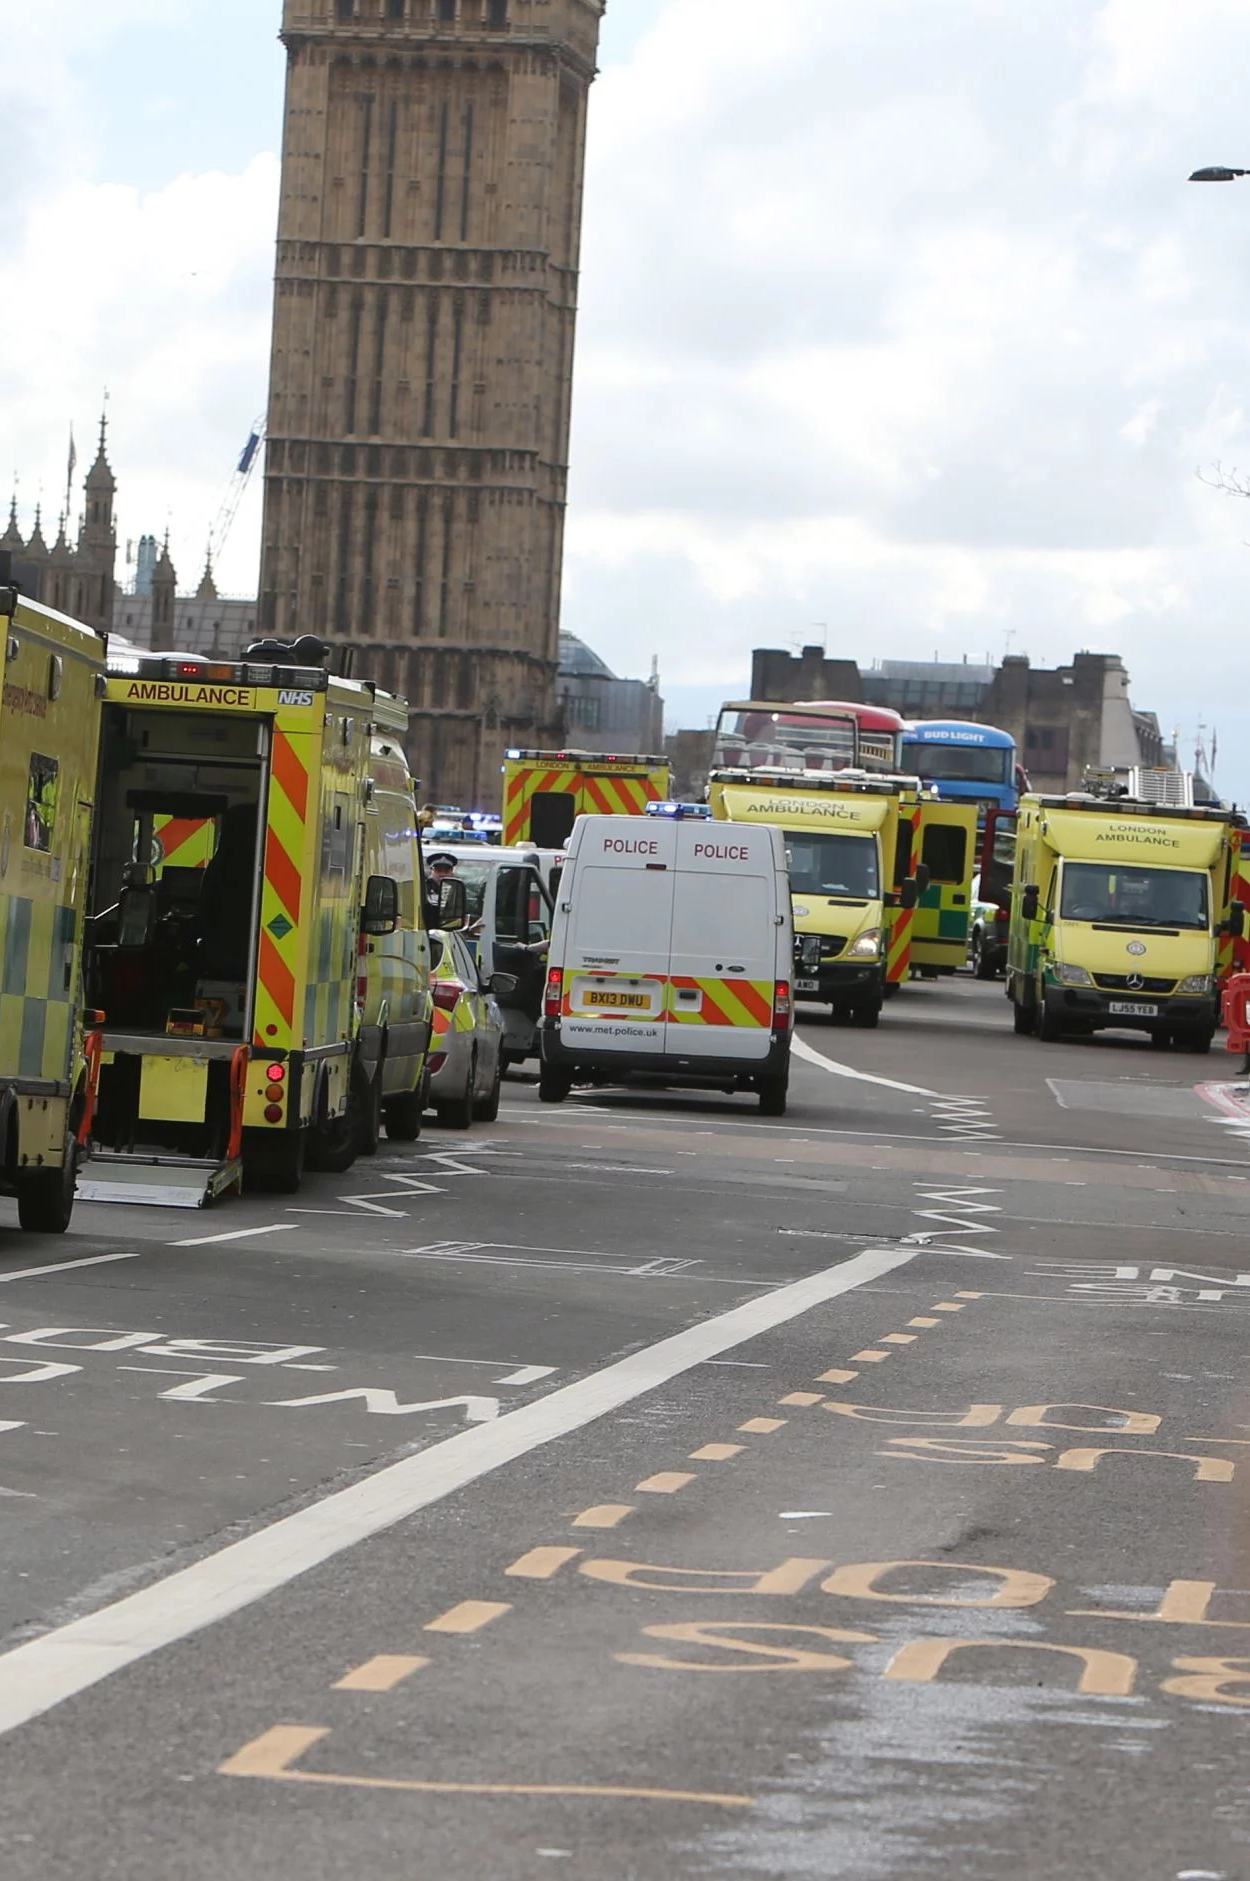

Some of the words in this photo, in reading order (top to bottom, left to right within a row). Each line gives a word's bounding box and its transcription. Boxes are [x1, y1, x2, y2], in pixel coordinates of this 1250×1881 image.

[127, 682, 250, 706] AMBULANCE
[279, 691, 313, 706] NHS
[924, 730, 950, 740] BUD
[950, 731, 986, 743] LIGHT
[535, 761, 570, 770] LONDON
[586, 764, 636, 773] AMBULANCE
[769, 799, 845, 811] LONDON
[746, 804, 862, 821] AMBULANCE
[1109, 825, 1167, 836] LONDON
[603, 838, 658, 855] POLICE
[1095, 833, 1181, 849] AMBULANCE
[694, 843, 749, 861] POLICE
[590, 991, 618, 1005] BX13
[620, 993, 644, 1007] DWU
[1111, 1003, 1136, 1014] LJ55
[568, 1025, 659, 1038] www.met.police.uk
